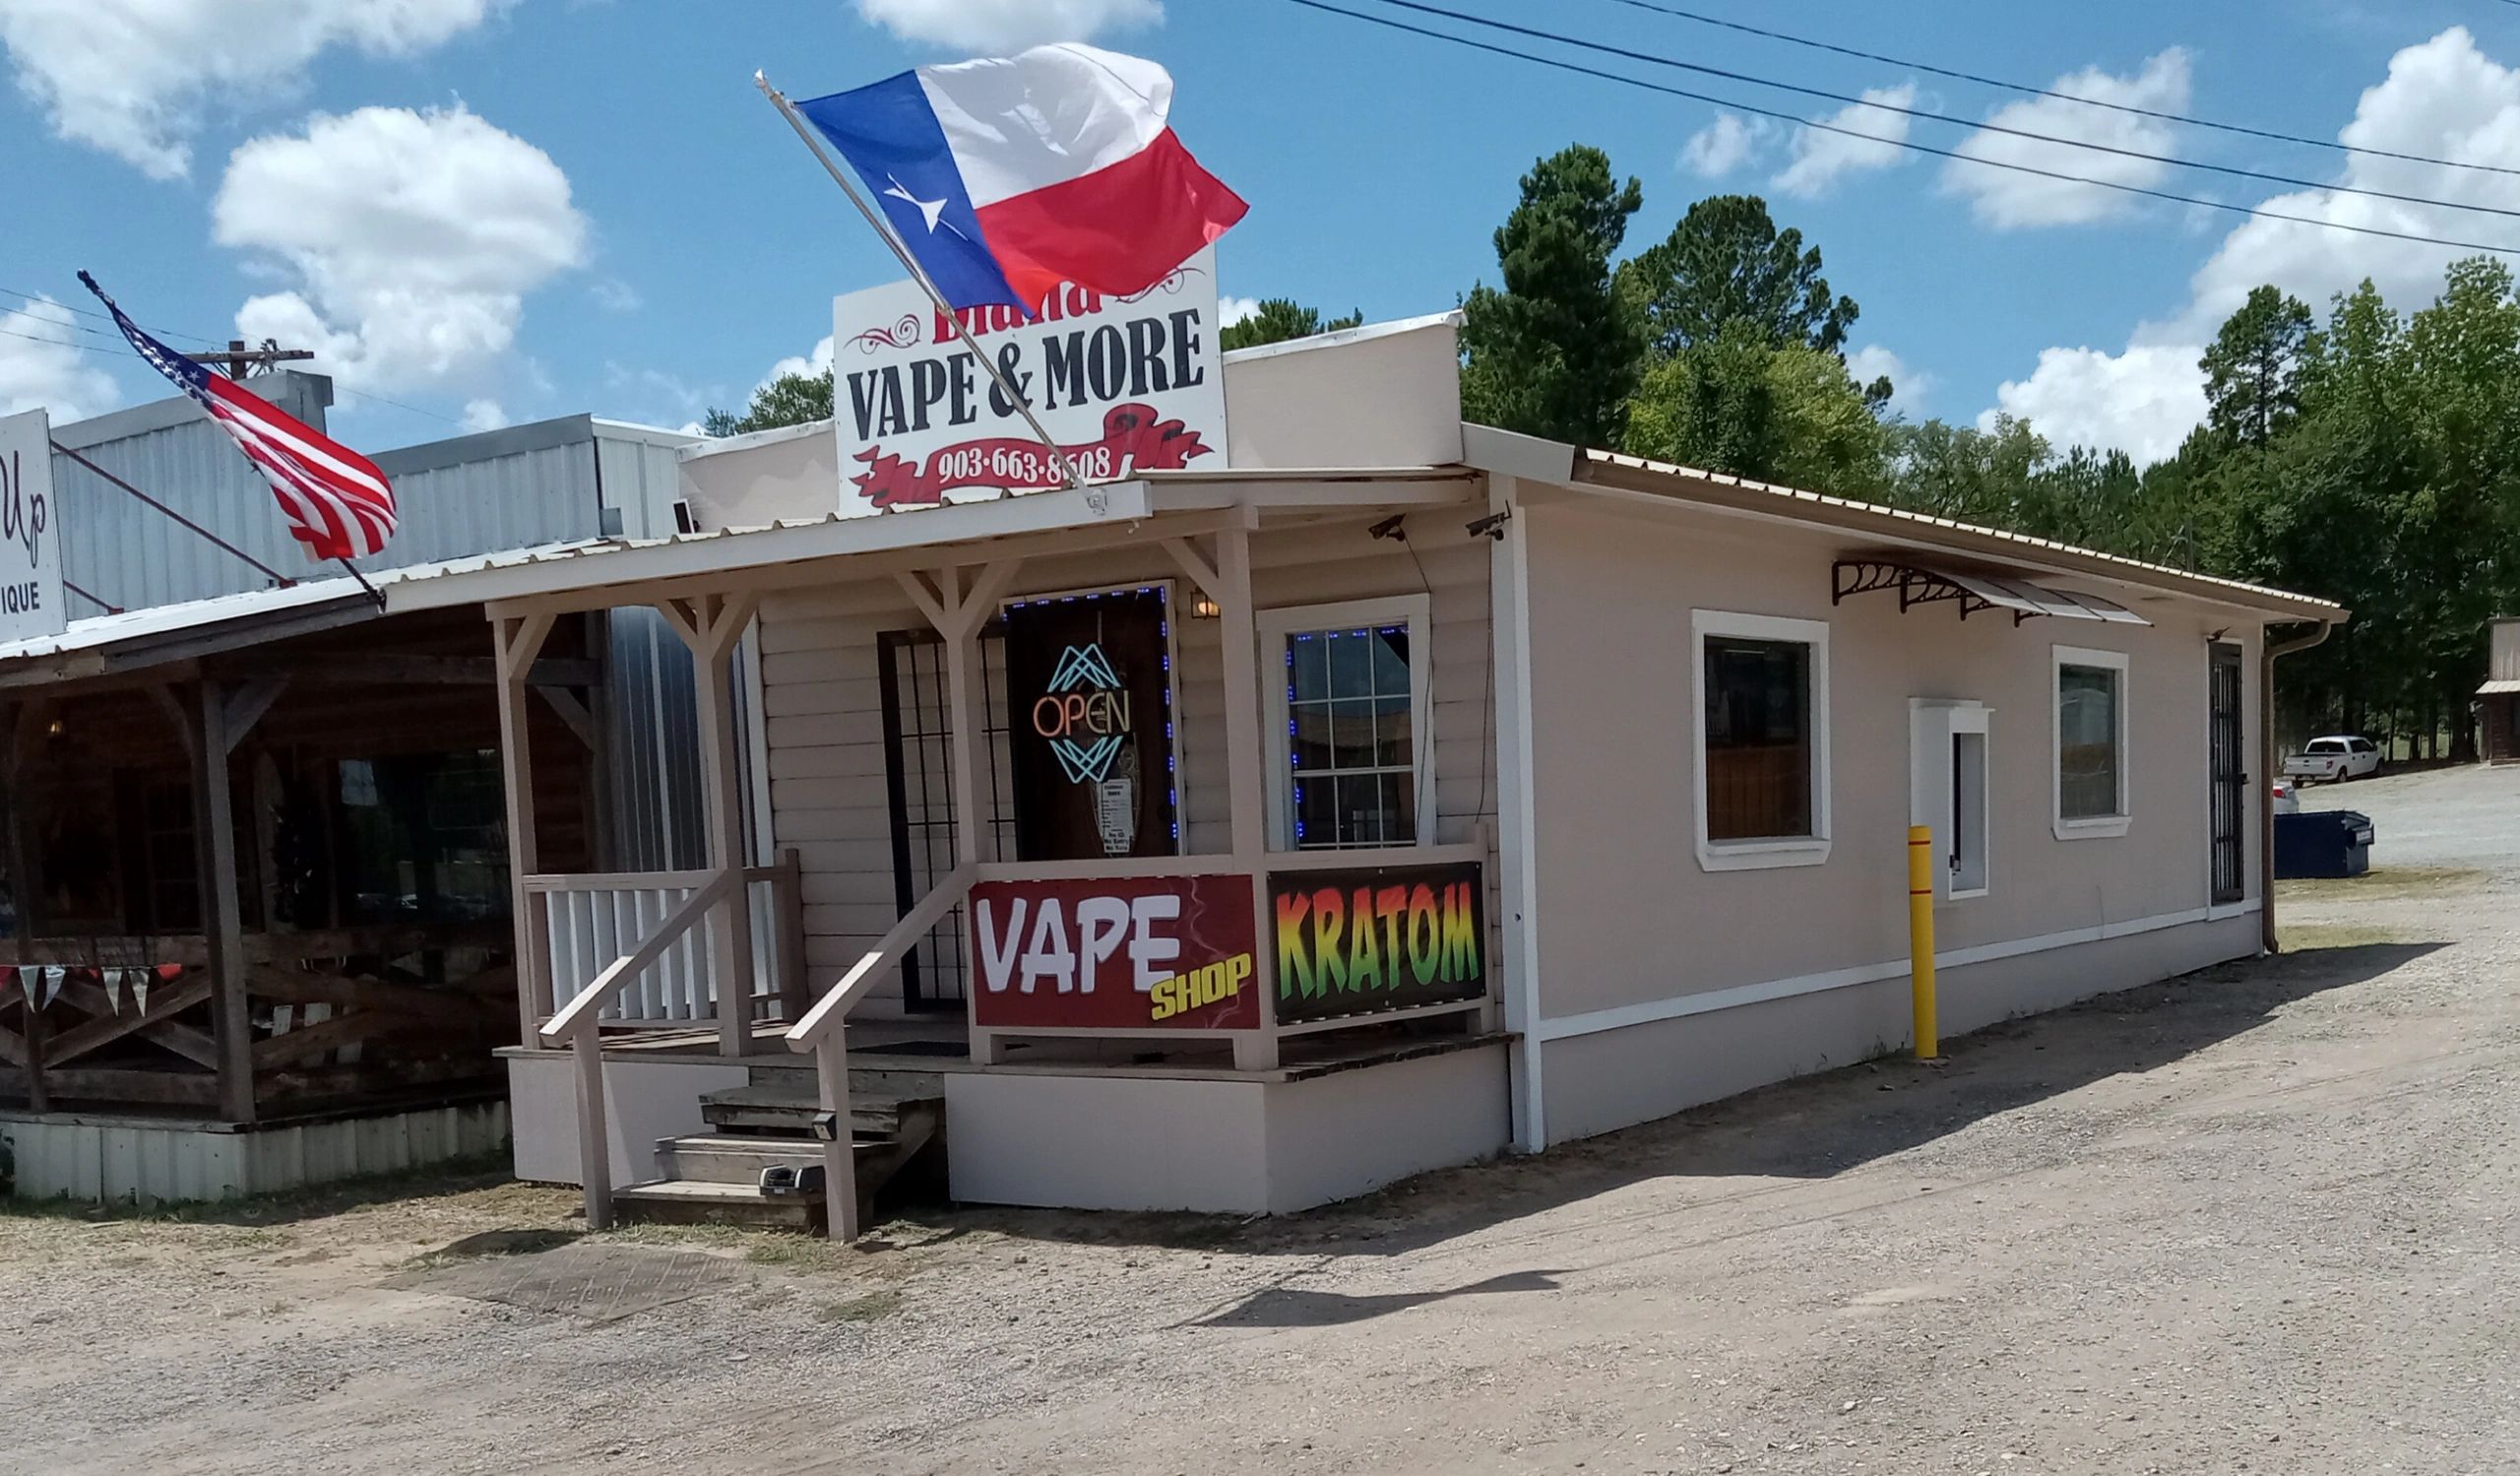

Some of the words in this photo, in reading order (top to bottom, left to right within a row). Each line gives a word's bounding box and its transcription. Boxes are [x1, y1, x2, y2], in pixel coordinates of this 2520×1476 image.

[847, 352, 977, 441] VAPE
[988, 342, 1033, 417] &
[1042, 308, 1204, 411] MORE
[1034, 690, 1130, 737] OPEN
[976, 894, 1181, 995] VAPE
[1150, 952, 1251, 1021] SHOP
[1276, 881, 1480, 1000] KRATOM
